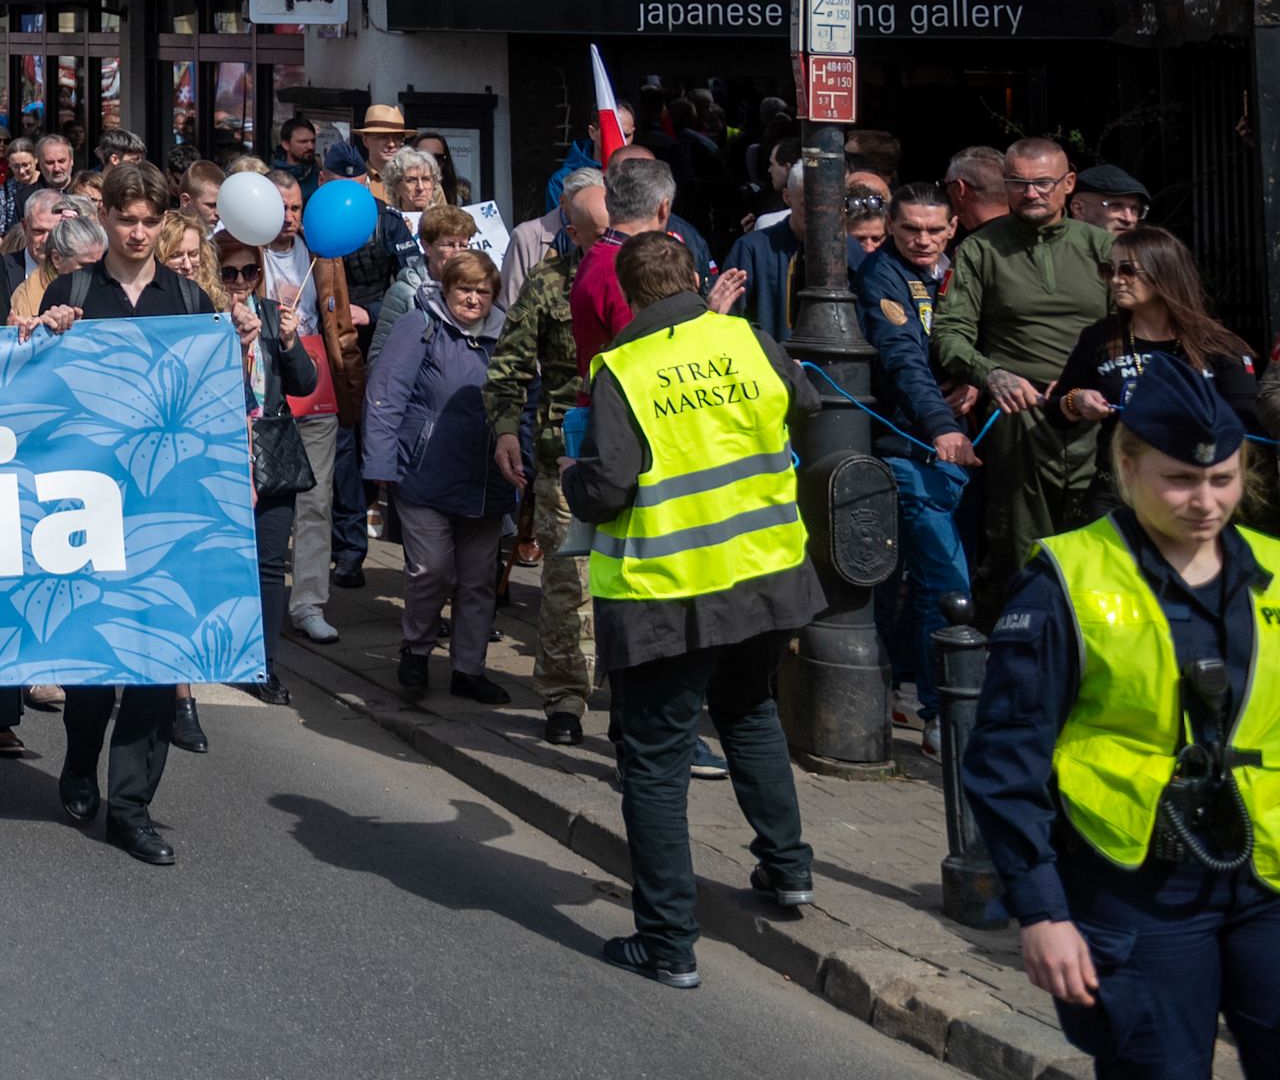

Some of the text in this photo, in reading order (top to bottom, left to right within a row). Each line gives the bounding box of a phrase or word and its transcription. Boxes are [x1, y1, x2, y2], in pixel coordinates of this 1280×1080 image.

[836, 9, 850, 20] 150
[837, 76, 852, 88] 150
[656, 353, 739, 389] STRAŻ
[653, 380, 760, 419] MARSZU
